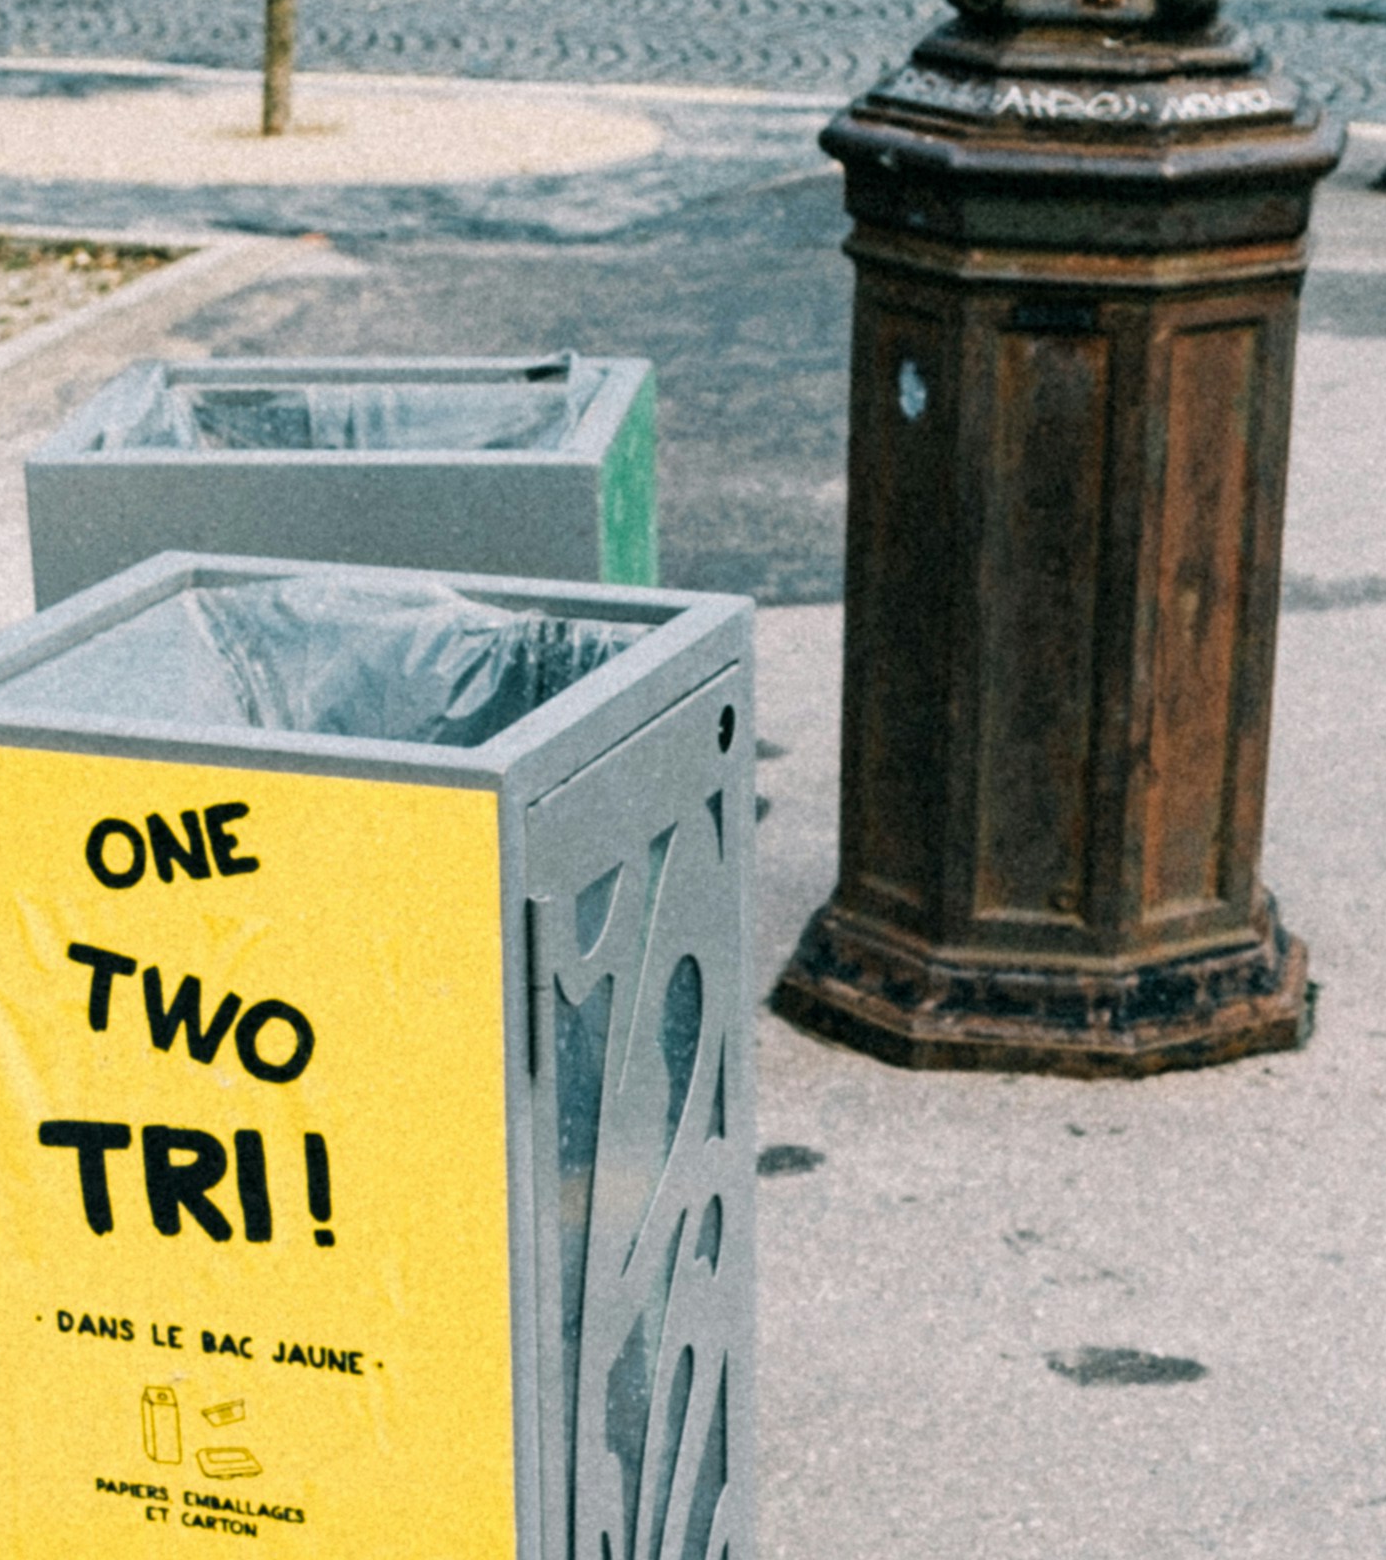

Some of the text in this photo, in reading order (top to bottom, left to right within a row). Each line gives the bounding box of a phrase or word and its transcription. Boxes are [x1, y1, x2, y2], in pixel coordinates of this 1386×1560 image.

[85, 801, 260, 890] ONE
[67, 942, 316, 1085] TWO
[56, 1309, 363, 1376] DANS LE BAC JAUNE
[145, 1505, 258, 1538] ET CARTON
[183, 1491, 305, 1524] EMBALLAGES
